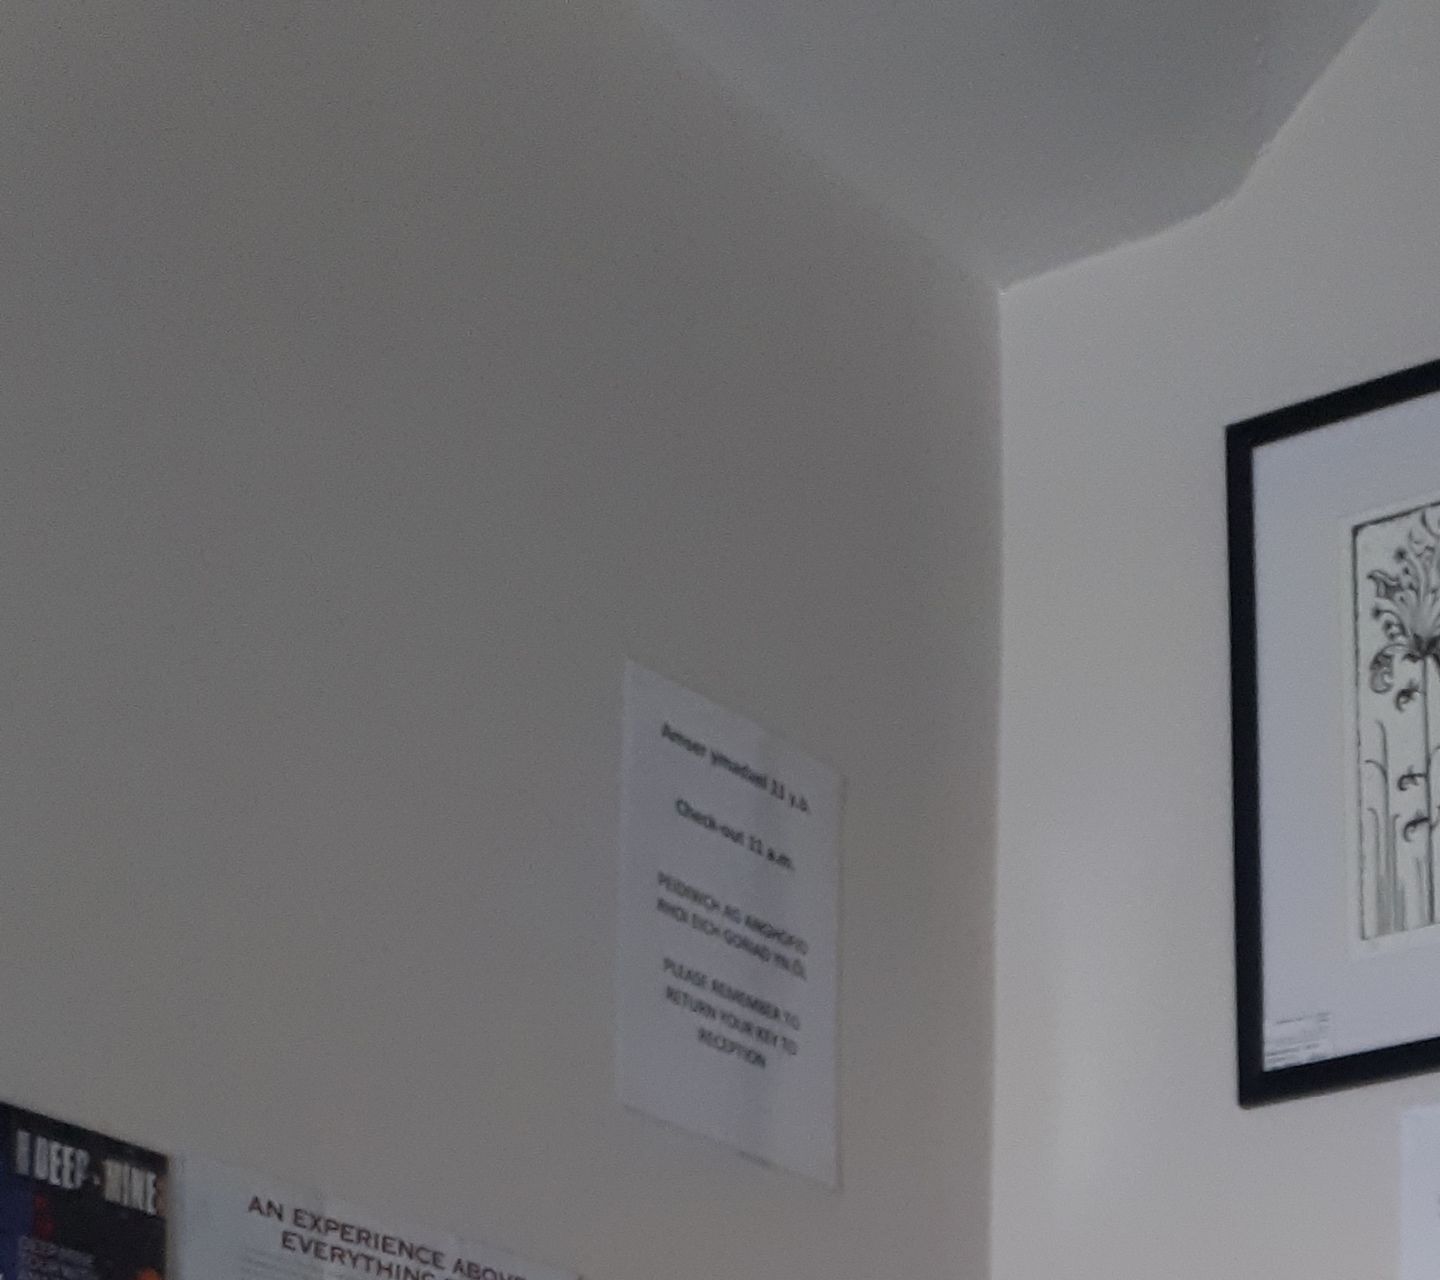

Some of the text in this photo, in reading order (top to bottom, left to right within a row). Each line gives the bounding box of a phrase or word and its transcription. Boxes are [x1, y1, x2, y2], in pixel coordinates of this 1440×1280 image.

[675, 797, 745, 846] Check-out
[663, 957, 708, 989] PLEASE
[712, 979, 781, 1022] REMEMBER
[665, 985, 716, 1020] RETURN
[697, 1027, 767, 1070] RECEPTION
[247, 1195, 284, 1222] AN
[292, 1208, 446, 1270] EXPERIENCE
